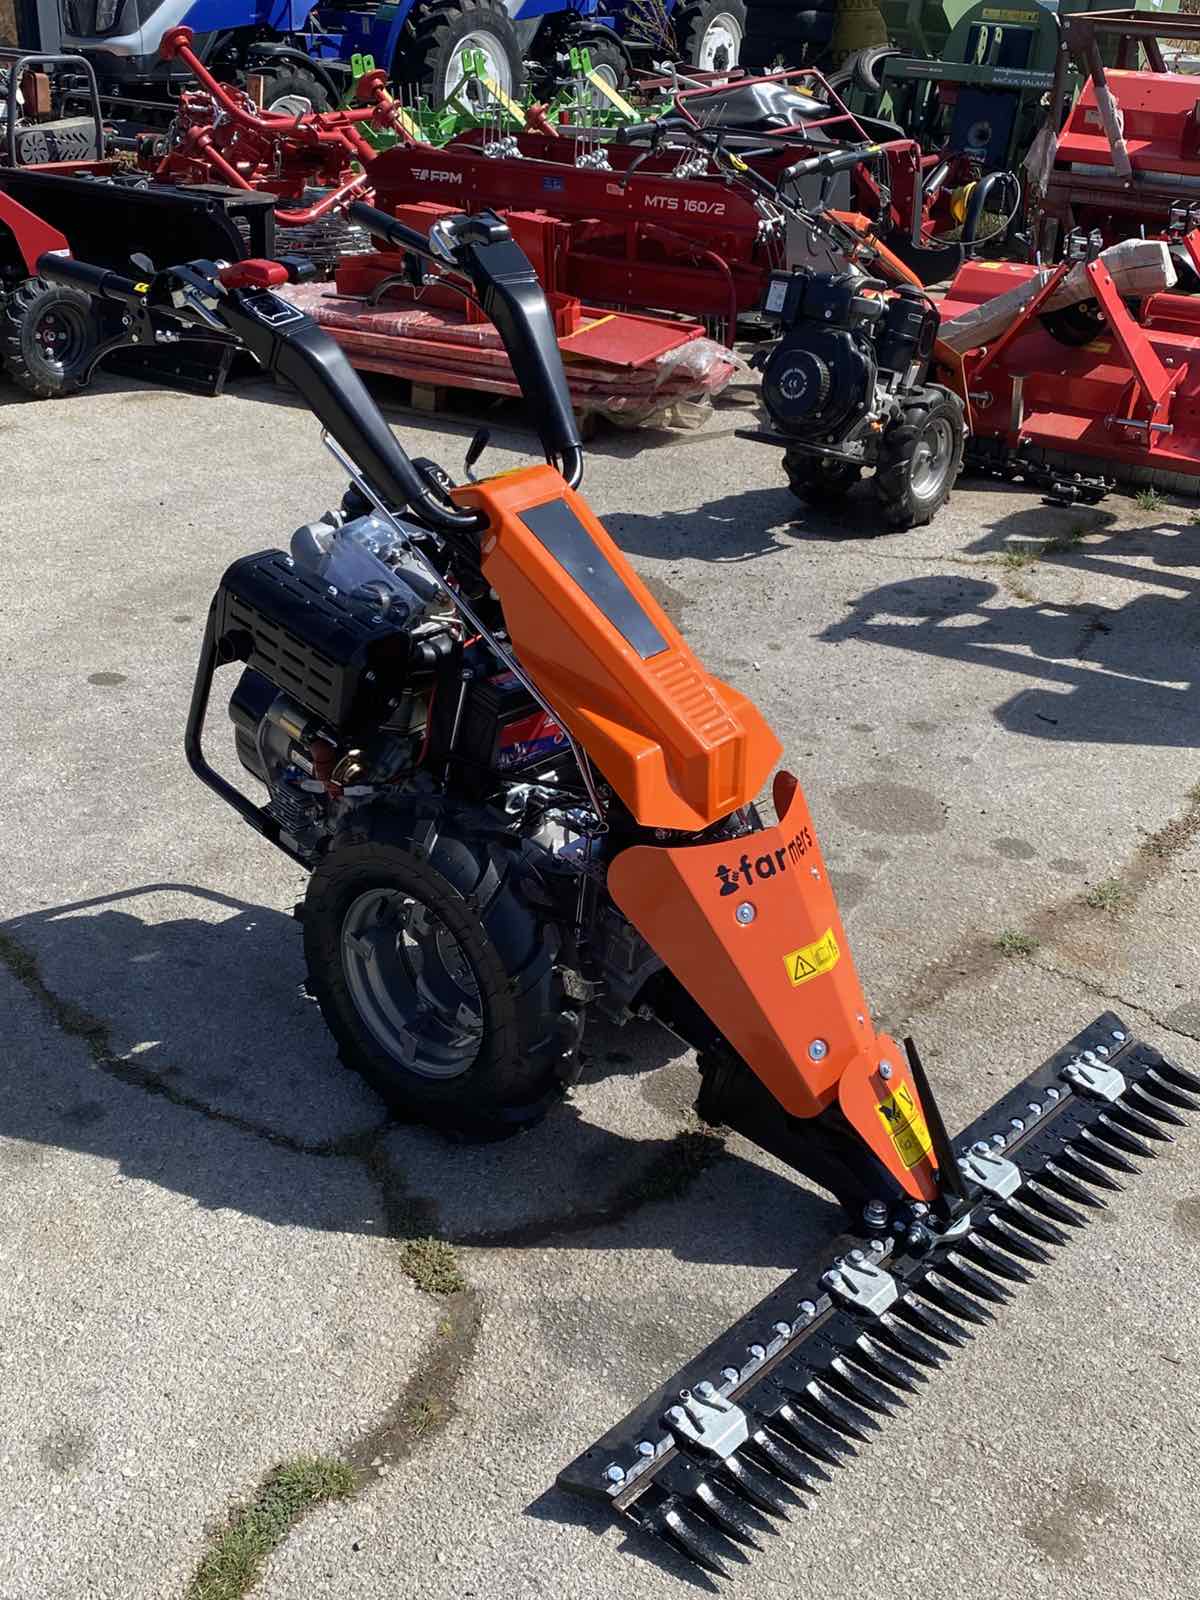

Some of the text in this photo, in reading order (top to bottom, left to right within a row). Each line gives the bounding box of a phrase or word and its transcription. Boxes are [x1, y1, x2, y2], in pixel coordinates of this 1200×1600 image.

[430, 170, 463, 184] FPM
[644, 194, 726, 216] MTS 160/2
[740, 825, 813, 885] farmers
